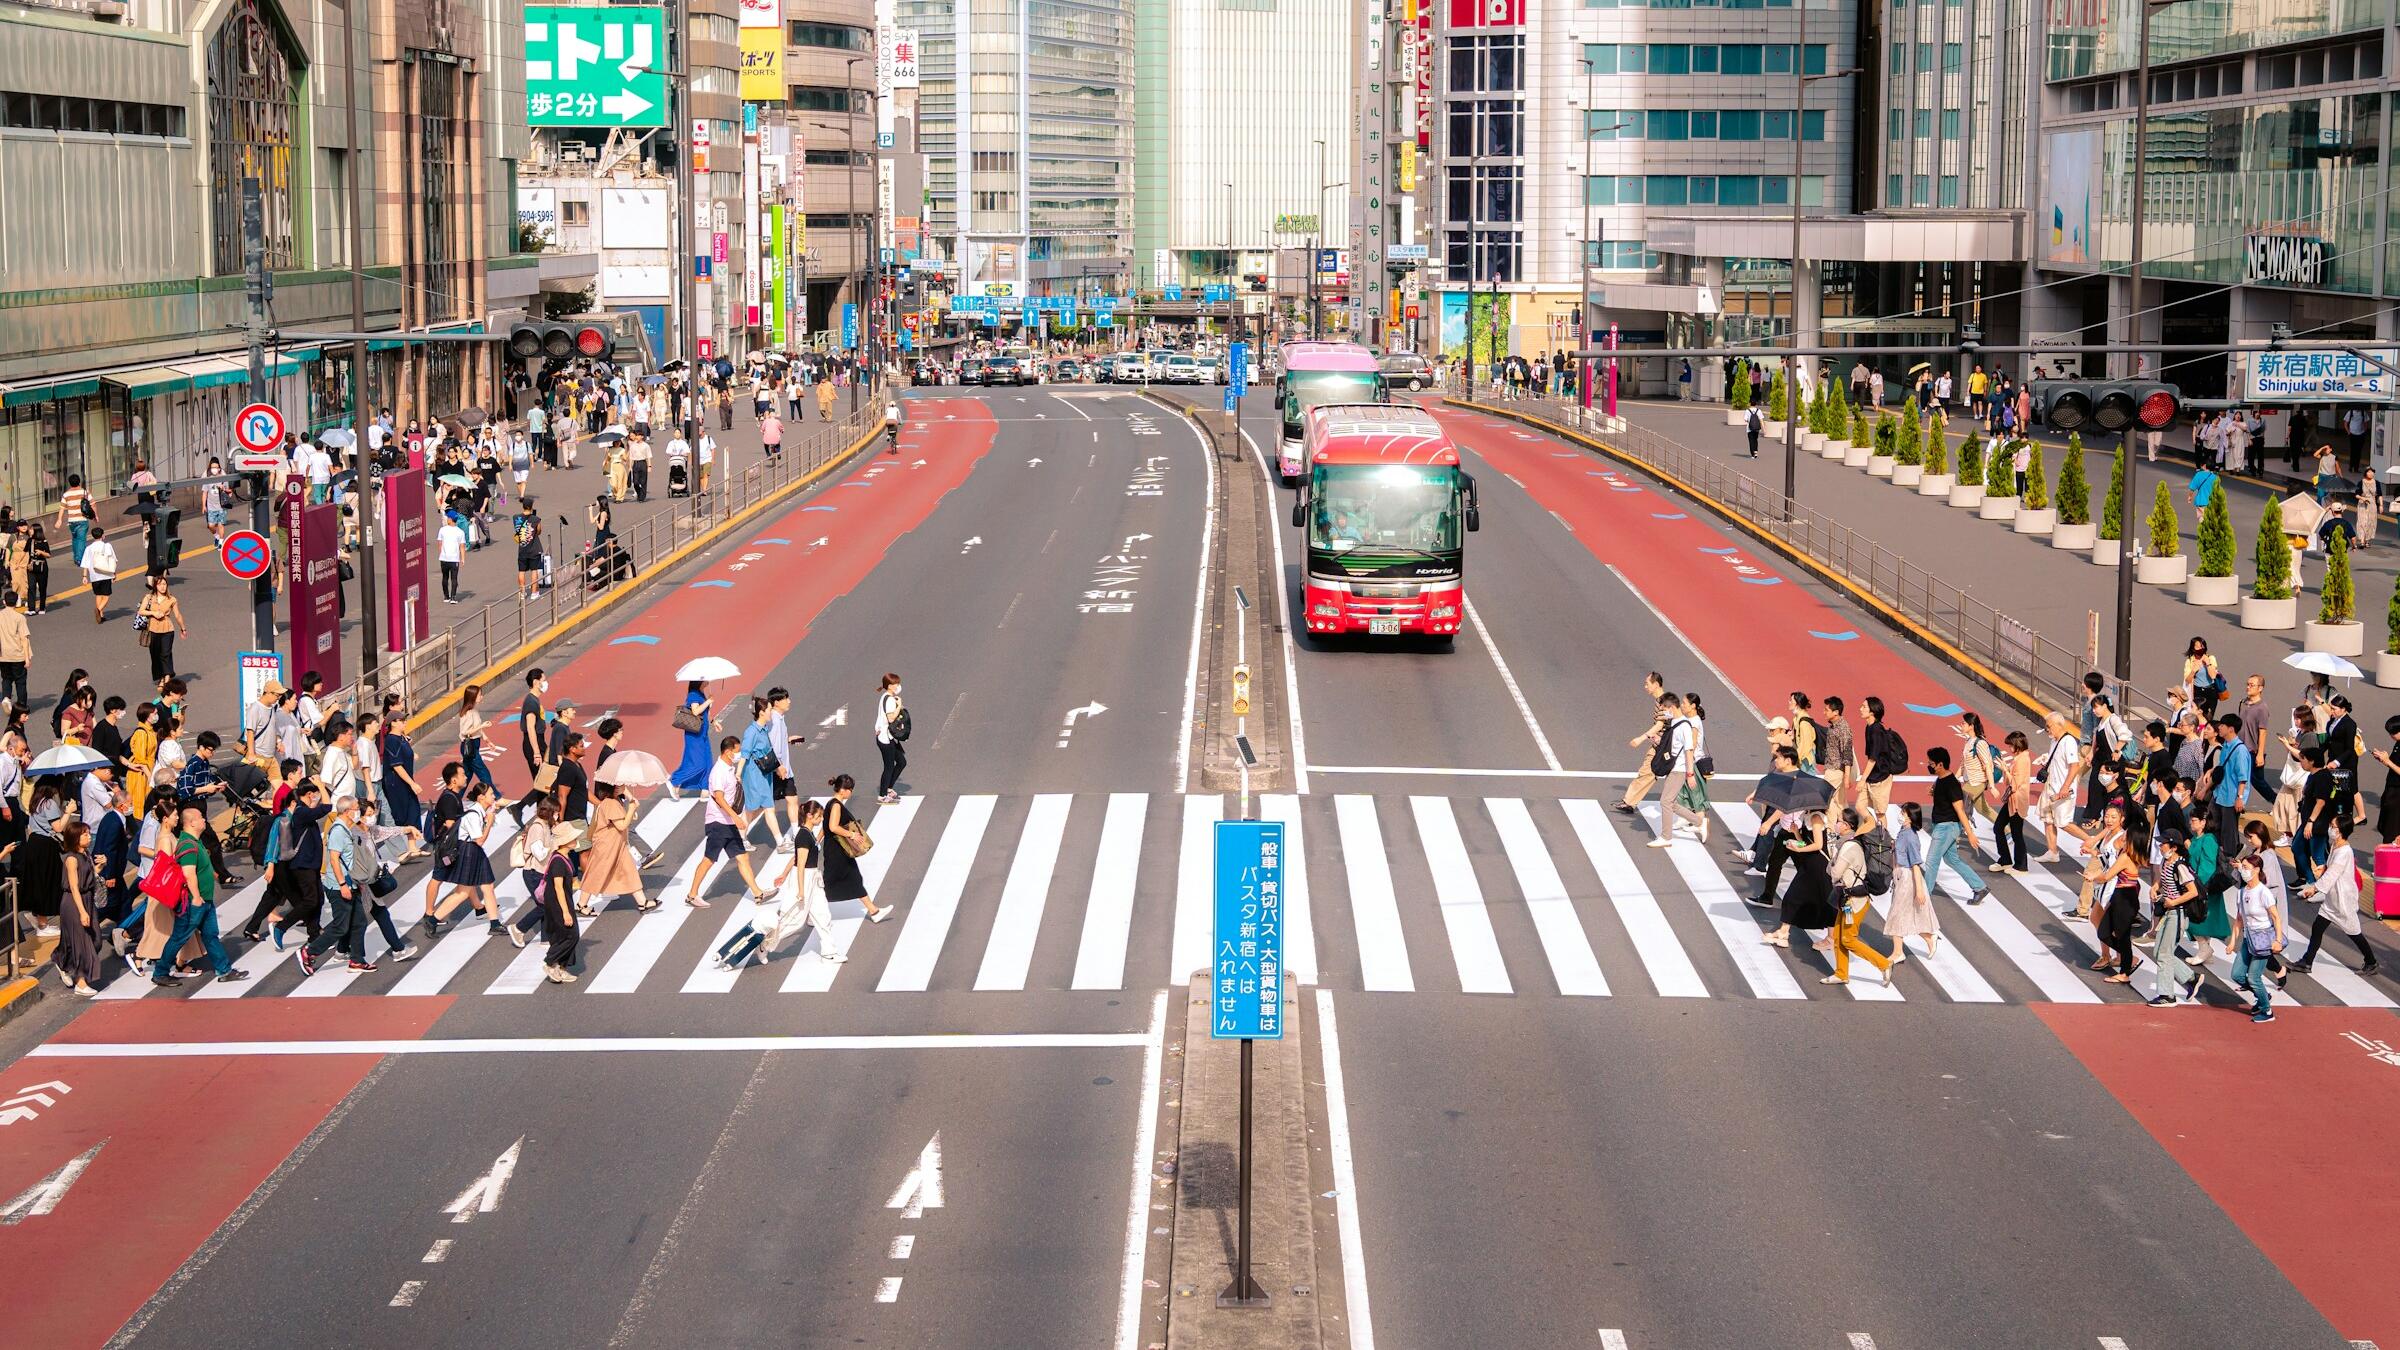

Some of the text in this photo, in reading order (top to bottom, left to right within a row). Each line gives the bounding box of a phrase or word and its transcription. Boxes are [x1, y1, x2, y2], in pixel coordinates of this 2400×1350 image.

[895, 43, 914, 63] 集
[894, 66, 915, 77] 666
[527, 92, 598, 117] 歩2分
[1370, 0, 1381, 186] 華カプセルホテル
[2258, 353, 2383, 378] 新宿駅南口
[2259, 379, 2317, 394] Shinjuku
[2323, 380, 2348, 393] Sta.
[2369, 380, 2382, 393] S.
[243, 657, 278, 667] お知らせ
[1240, 866, 1257, 994] バスタ新宿へは
[1260, 832, 1278, 1031] 一般車・貸切バス・大型貨物車は
[1219, 941, 1237, 1031] 入れません
